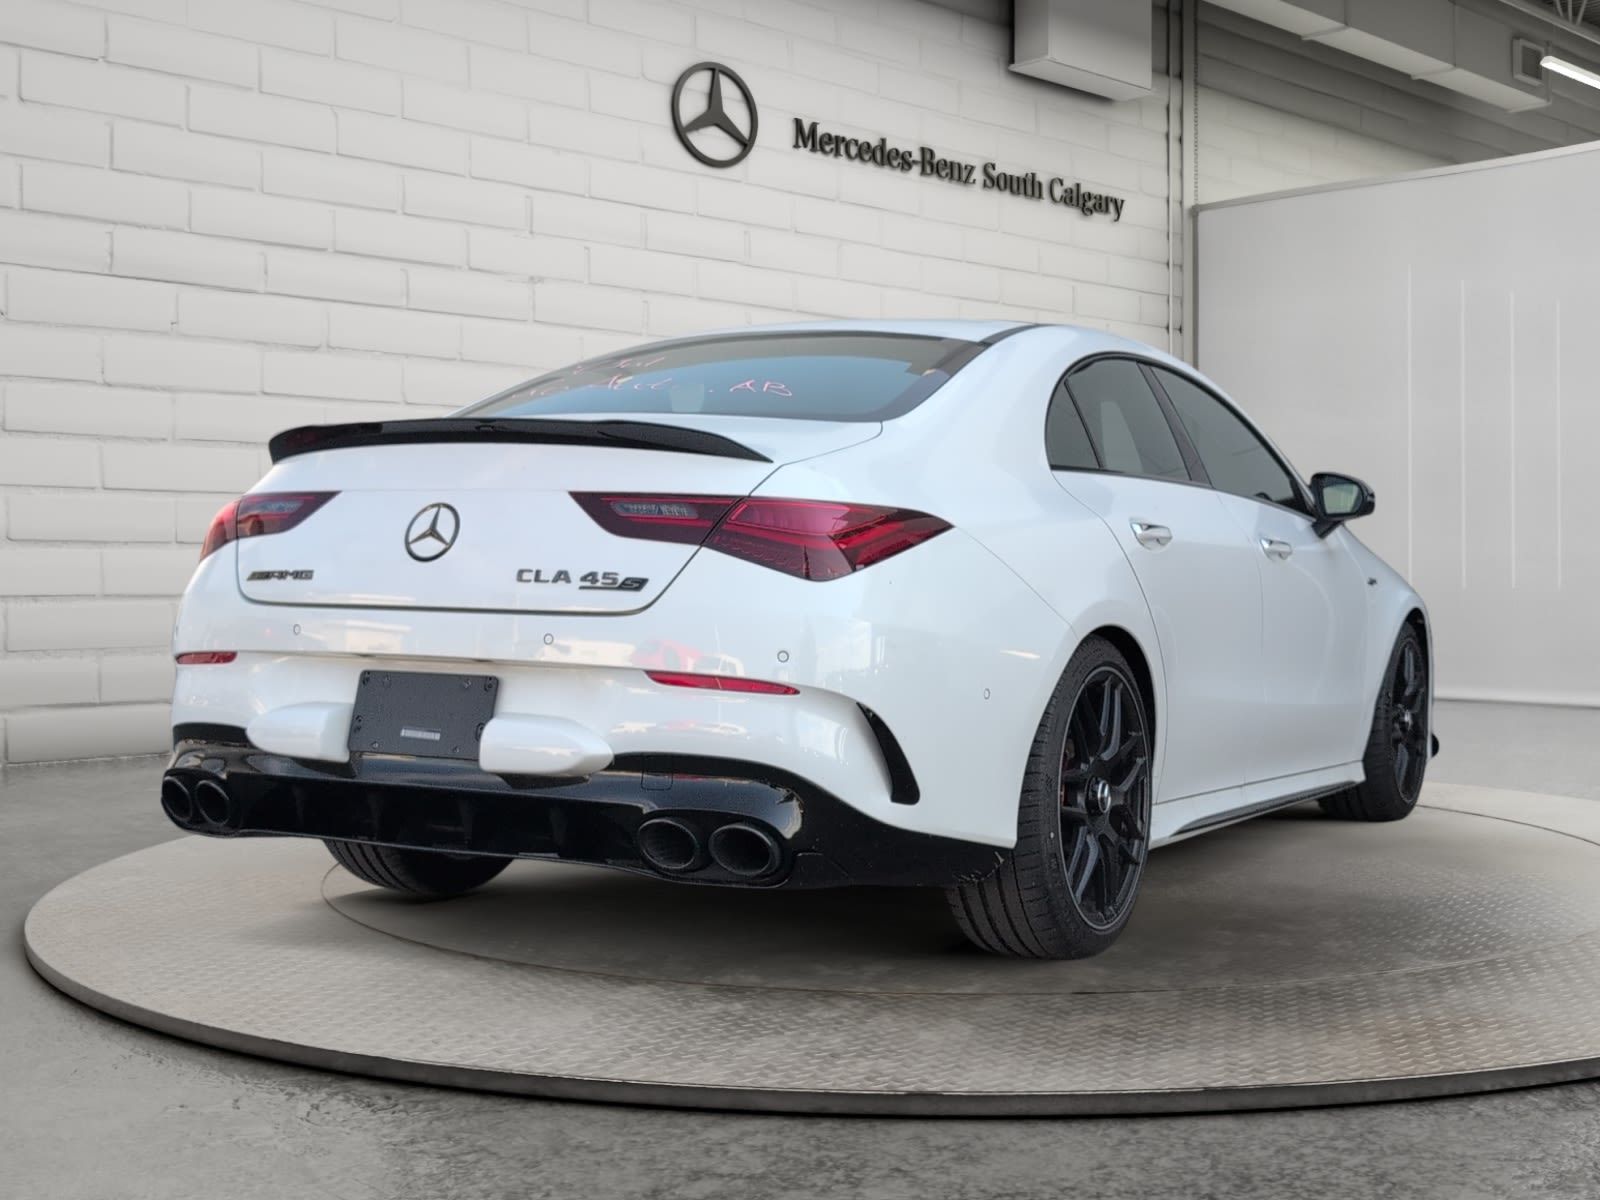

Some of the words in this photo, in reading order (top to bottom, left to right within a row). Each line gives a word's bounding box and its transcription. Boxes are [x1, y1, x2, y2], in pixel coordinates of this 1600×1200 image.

[792, 117, 977, 185] Mercedes-Benz
[982, 162, 1044, 200] South
[1049, 177, 1126, 222] Calgary
[260, 569, 315, 581] AMG
[516, 568, 572, 584] CLA
